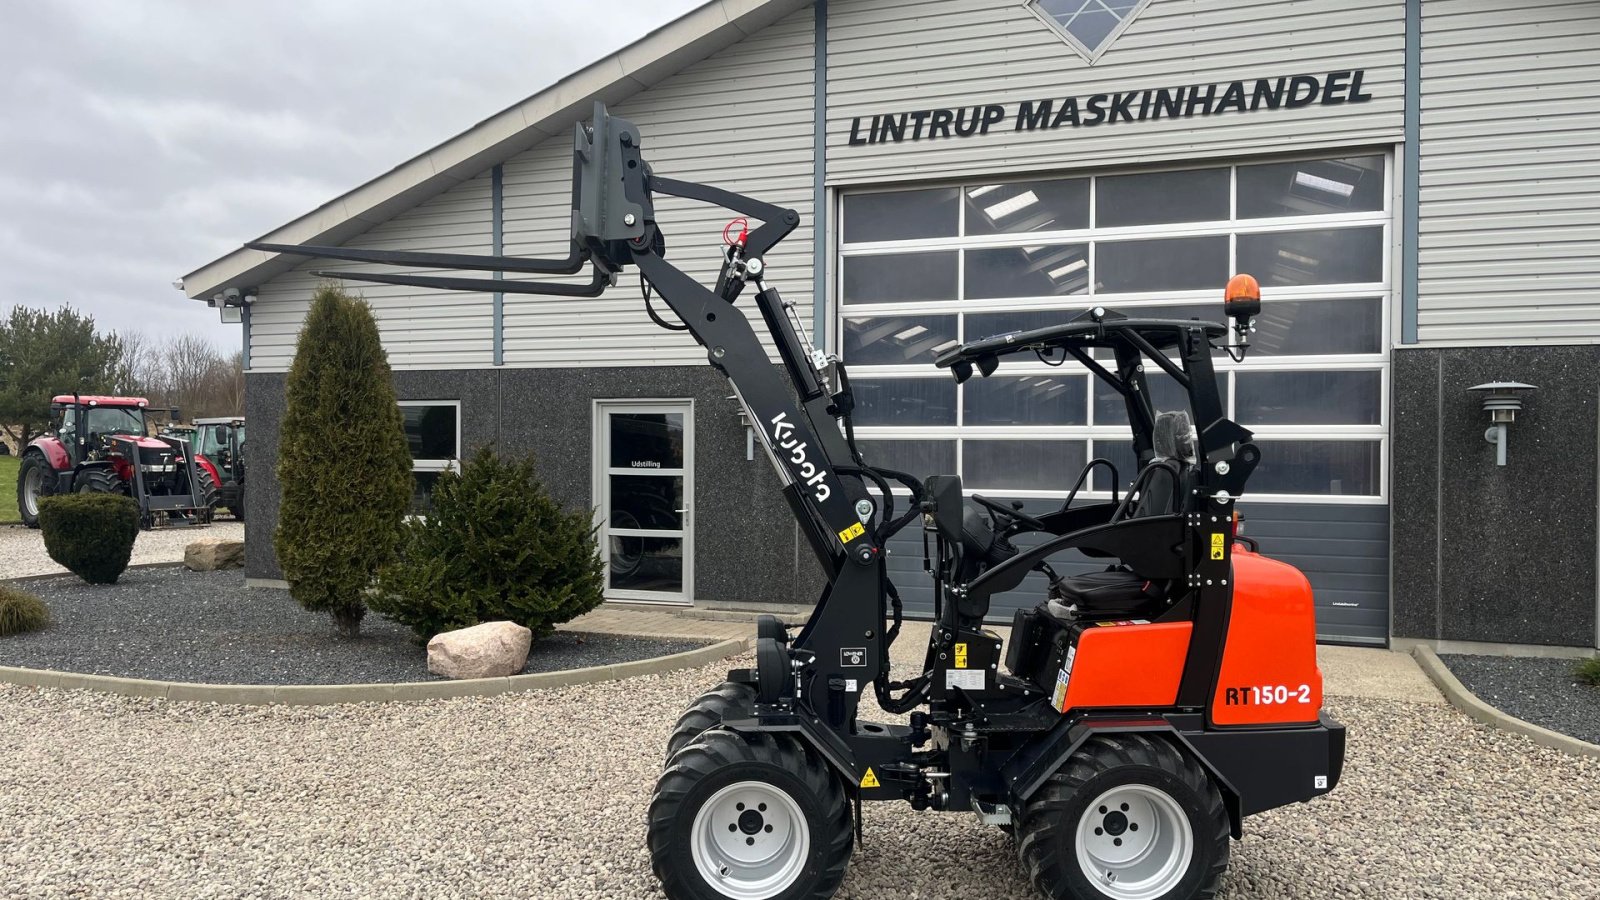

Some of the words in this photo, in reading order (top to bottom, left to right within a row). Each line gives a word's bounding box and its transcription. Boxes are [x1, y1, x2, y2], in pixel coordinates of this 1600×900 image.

[849, 104, 1005, 147] LINTRUP
[1015, 71, 1372, 132] MASKINHANDEL
[631, 460, 661, 468] Udstilling
[770, 411, 831, 503] Kubota
[1226, 684, 1311, 705] RT150-2
